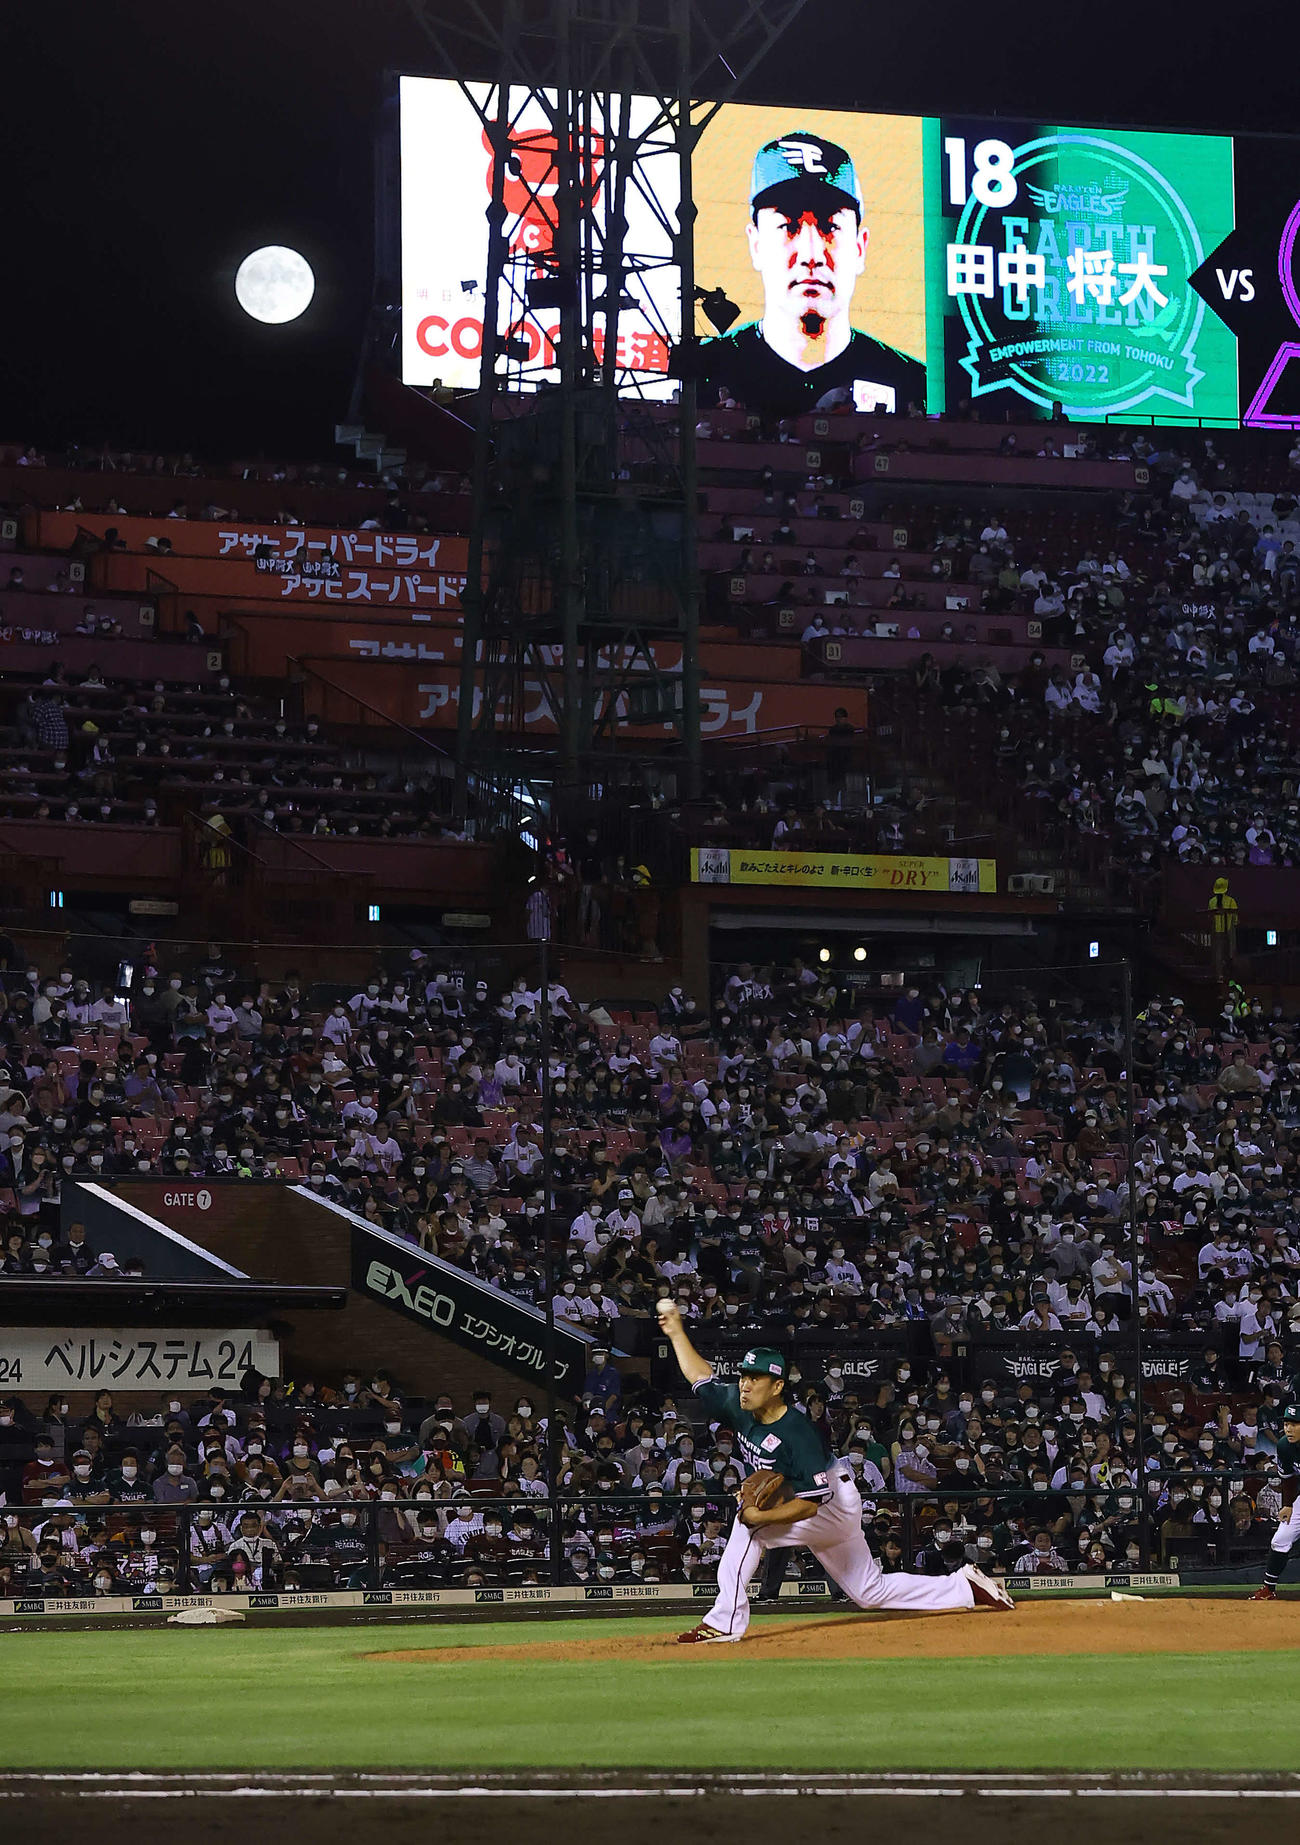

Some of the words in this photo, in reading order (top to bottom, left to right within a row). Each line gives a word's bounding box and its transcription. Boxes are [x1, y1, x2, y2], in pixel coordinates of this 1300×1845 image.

[945, 137, 1018, 208] 18
[1034, 186, 1121, 216] EAGLES
[946, 243, 1045, 301] 田中
[1067, 247, 1168, 308] 将大
[1215, 268, 1256, 302] VS
[989, 339, 1084, 362] EMPOWERMENT
[1087, 340, 1121, 356] FROM
[1125, 345, 1175, 371] TOHOKU
[1058, 363, 1109, 384] 2022
[701, 861, 729, 874] Asahi
[740, 862, 825, 875] 飲みごたえとキレのよさ
[951, 870, 978, 884] Asahi
[164, 1193, 195, 1206] GATE
[365, 1260, 456, 1327] EXEO
[459, 1312, 569, 1380] エクシオグルプ
[44, 1338, 255, 1380] ベルシステム24
[0, 1358, 23, 1382] 24
[1008, 1359, 1058, 1378] EAGLES
[1012, 1579, 1030, 1588] SMBC
[1033, 1578, 1074, 1587] 三井住友銀行
[1111, 1577, 1129, 1586] SMBC
[1132, 1576, 1173, 1585] 三井住友銀行
[593, 1588, 612, 1597] SMBC
[615, 1588, 659, 1597] 三井住友銀行
[806, 1584, 825, 1592] SMBC
[257, 1597, 278, 1605] SMBC
[282, 1595, 328, 1604] 三井住友銀行
[371, 1593, 391, 1602] SMBC
[395, 1592, 440, 1602] 三井住友銀行
[483, 1592, 503, 1600] SMBC
[506, 1590, 551, 1599] 三井住友銀行
[22, 1602, 44, 1611] SMBC
[48, 1600, 95, 1610] 三井住友銀行
[141, 1599, 162, 1608] SMBC
[165, 1598, 213, 1607] 三井住友銀行
